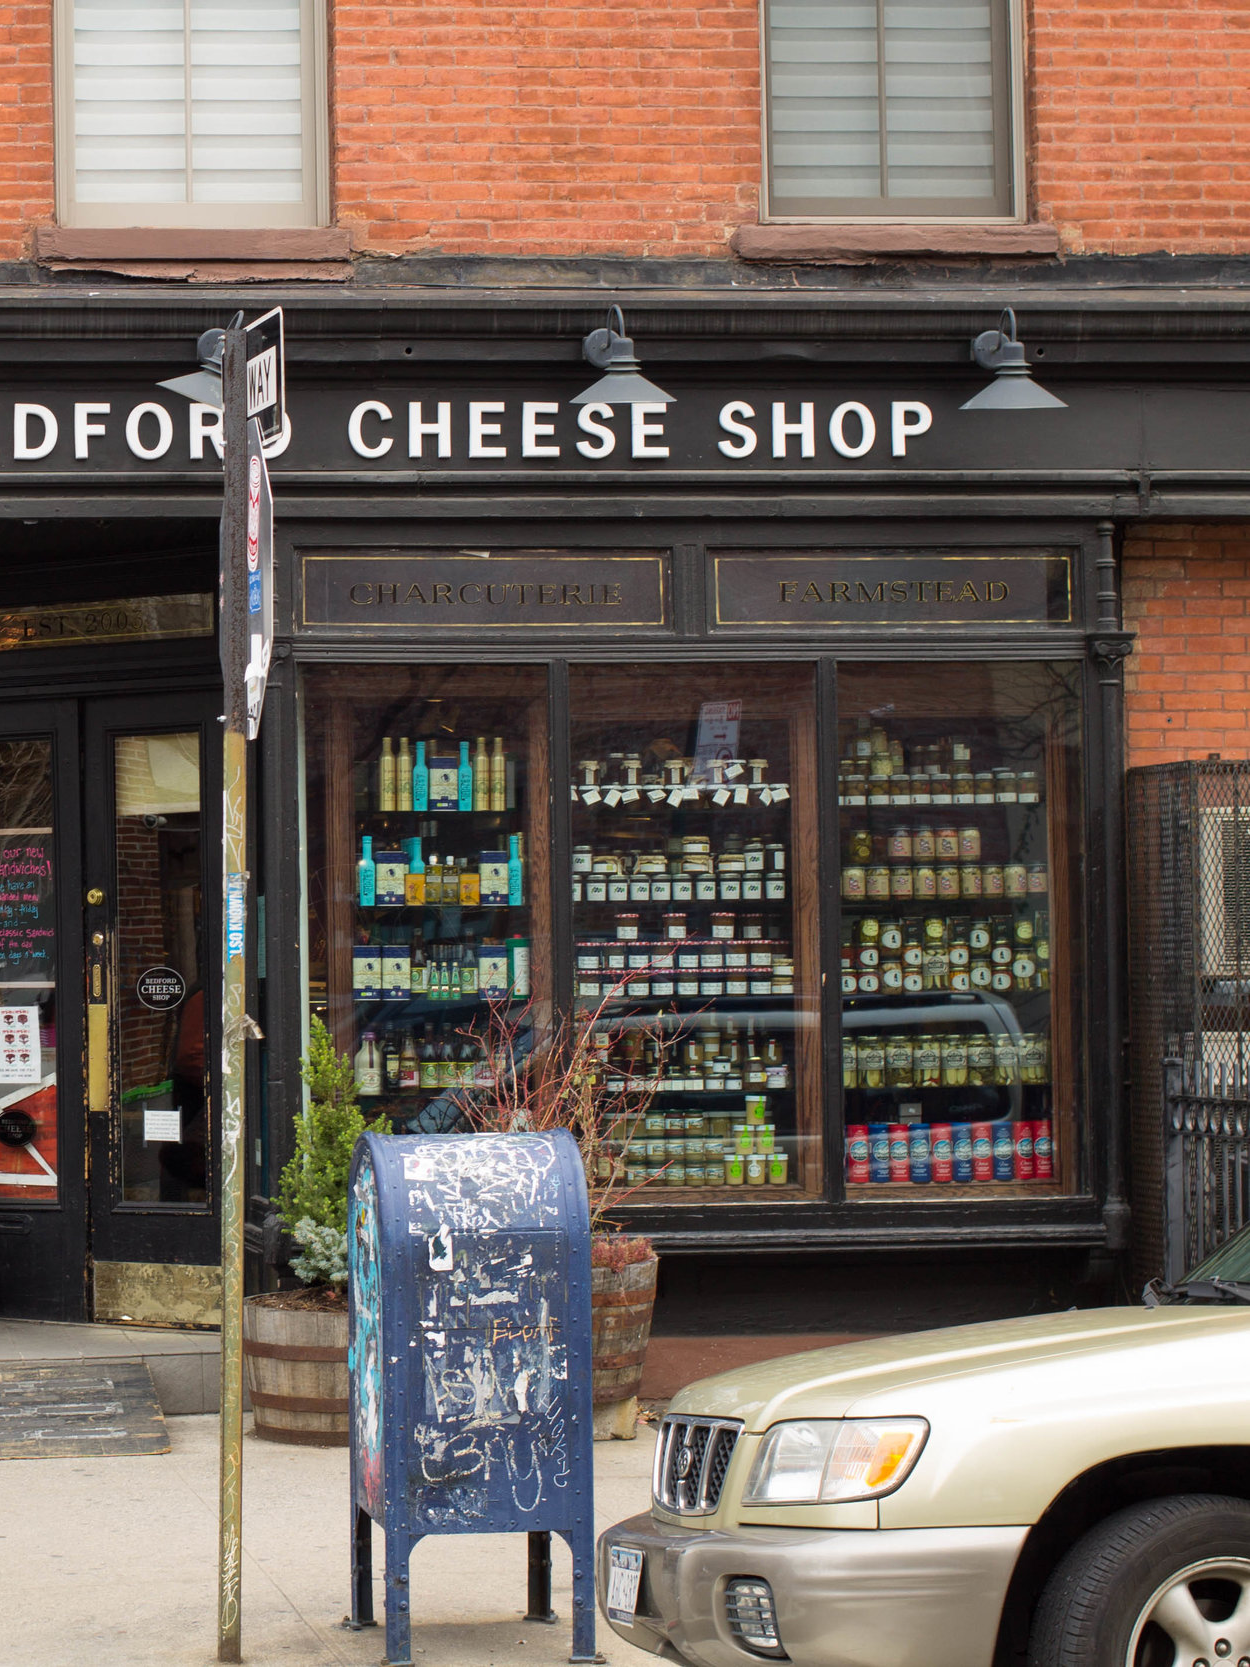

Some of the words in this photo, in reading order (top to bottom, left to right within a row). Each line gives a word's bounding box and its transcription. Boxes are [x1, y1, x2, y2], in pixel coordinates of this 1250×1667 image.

[248, 355, 272, 411] WAY
[348, 400, 670, 460] CHEESE
[718, 400, 933, 459] SHOP
[350, 581, 623, 606] CHARCUTERIE
[778, 580, 1010, 604] FARMSTEAD
[23, 614, 73, 639] EST.
[85, 608, 144, 633] 2003
[3, 848, 20, 858] our
[26, 847, 44, 858] new
[7, 880, 24, 890] have
[229, 891, 243, 931] KNOWN
[0, 928, 24, 937] classic
[8, 939, 19, 948] the
[229, 933, 243, 957] LSO
[8, 951, 22, 965] days
[141, 984, 181, 994] CHEESE
